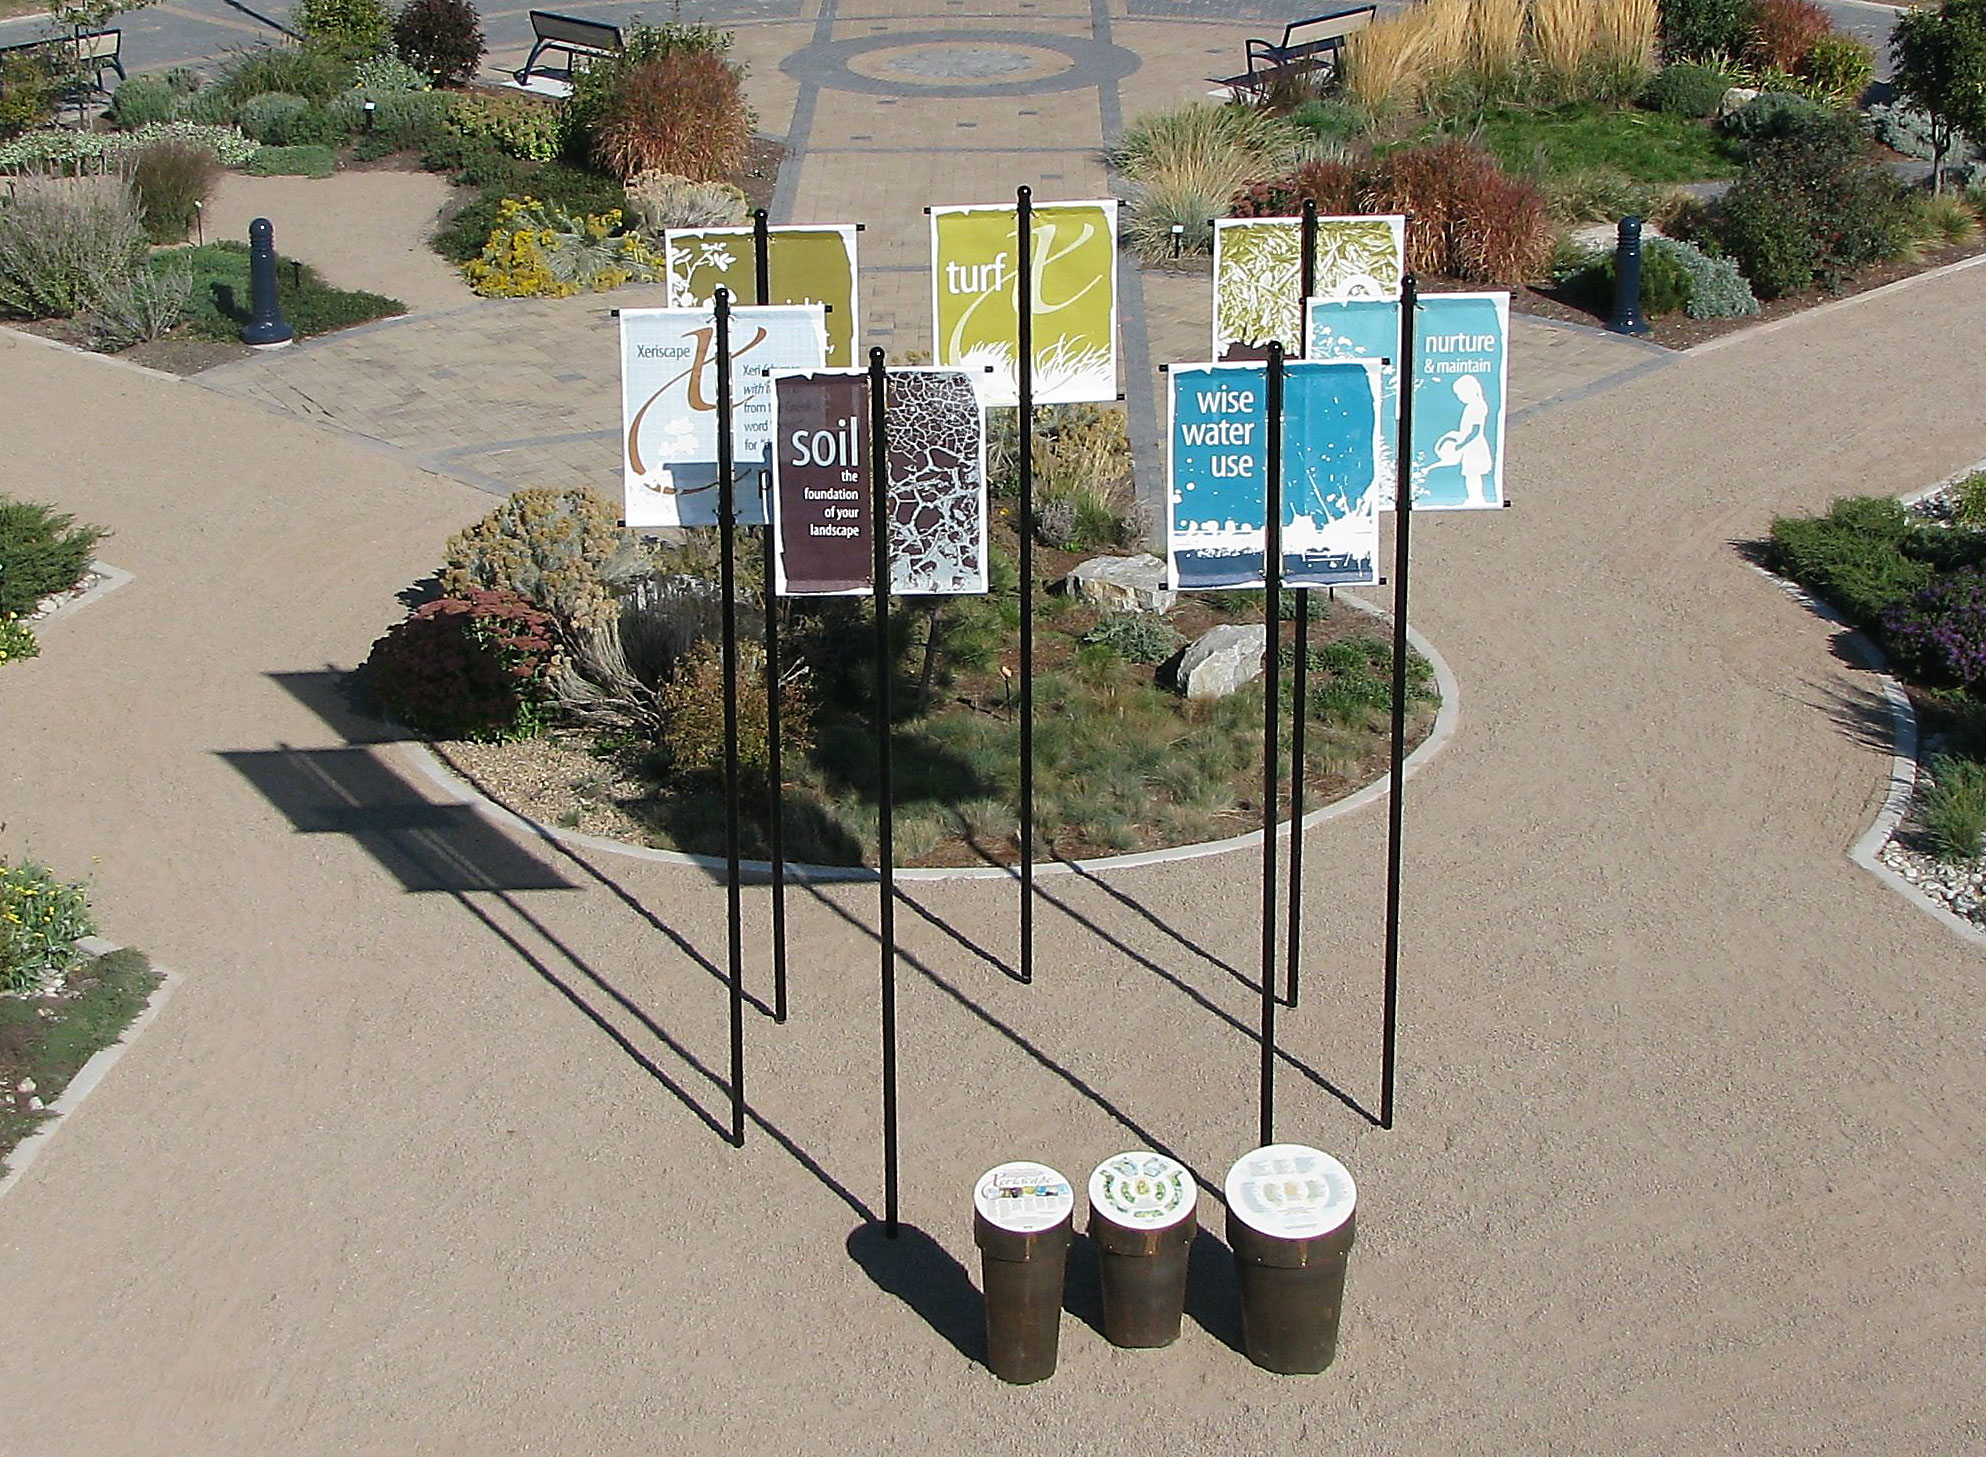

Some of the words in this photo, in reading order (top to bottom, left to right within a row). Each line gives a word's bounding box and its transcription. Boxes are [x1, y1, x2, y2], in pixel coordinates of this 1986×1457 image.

[946, 252, 1008, 294] turf
[1425, 332, 1495, 353] nurture
[637, 344, 691, 361] Xeriscape
[1423, 358, 1435, 374] &
[1436, 358, 1491, 373] maintain
[743, 383, 763, 395] with
[1196, 384, 1254, 414] wise
[744, 402, 766, 413] from
[744, 420, 768, 432] word
[1181, 419, 1255, 446] water
[744, 439, 757, 450] for
[792, 416, 858, 467] soil
[1211, 454, 1254, 478] use
[841, 469, 859, 482] the
[804, 487, 859, 500] foundation
[824, 506, 835, 518] of
[836, 507, 859, 520] your
[810, 523, 860, 539] landscape
